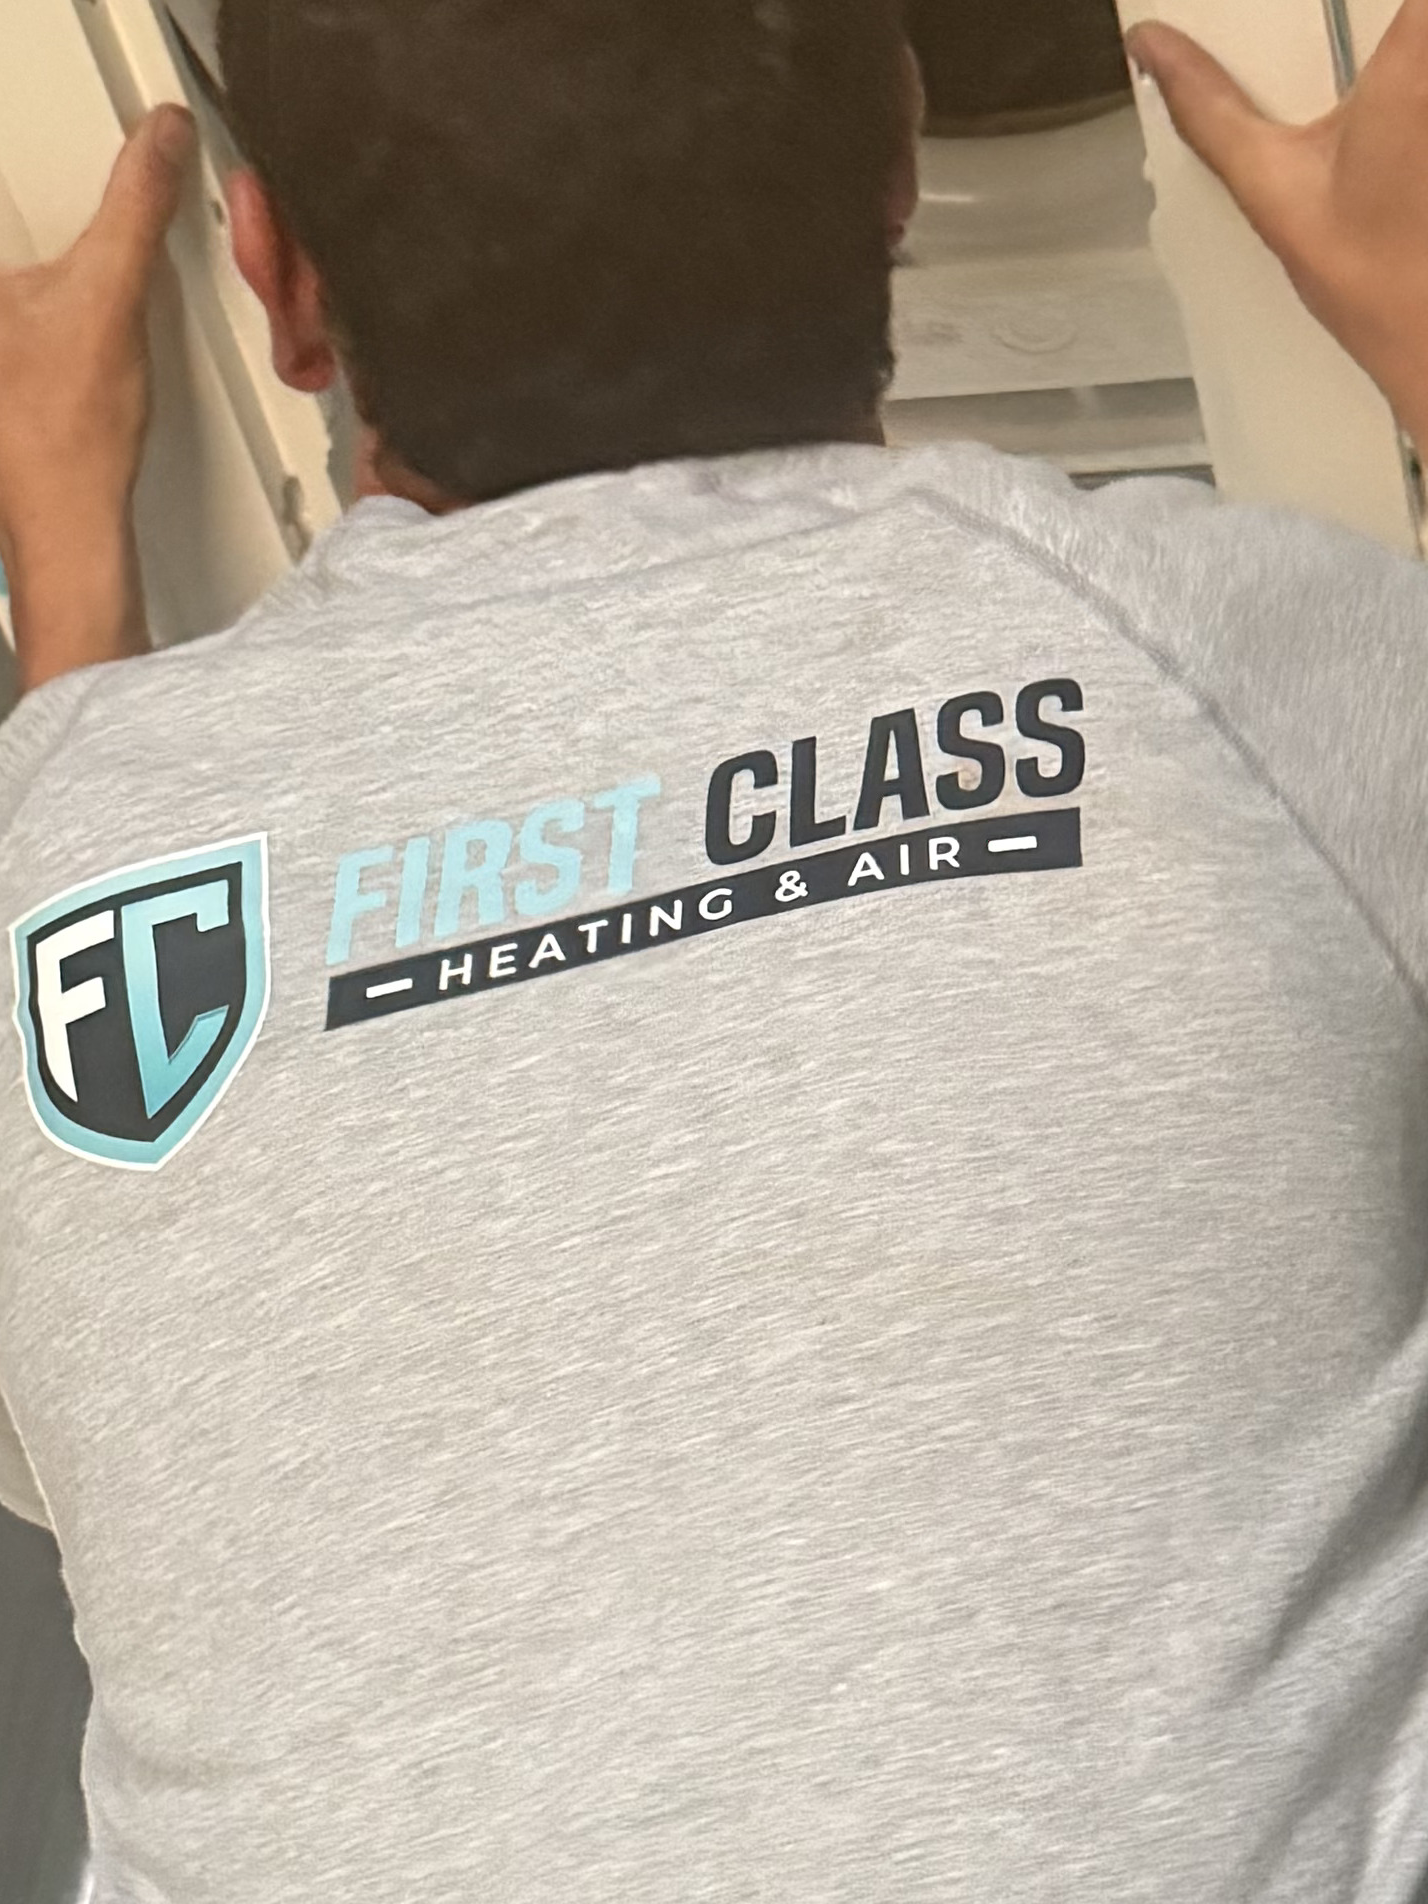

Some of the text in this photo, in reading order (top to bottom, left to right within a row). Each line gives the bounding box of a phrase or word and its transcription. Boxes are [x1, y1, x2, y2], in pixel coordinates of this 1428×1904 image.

[325, 678, 1085, 965] FIRST CLASS
[438, 836, 961, 990] HEATING & AIR
[35, 879, 229, 1119] FC
